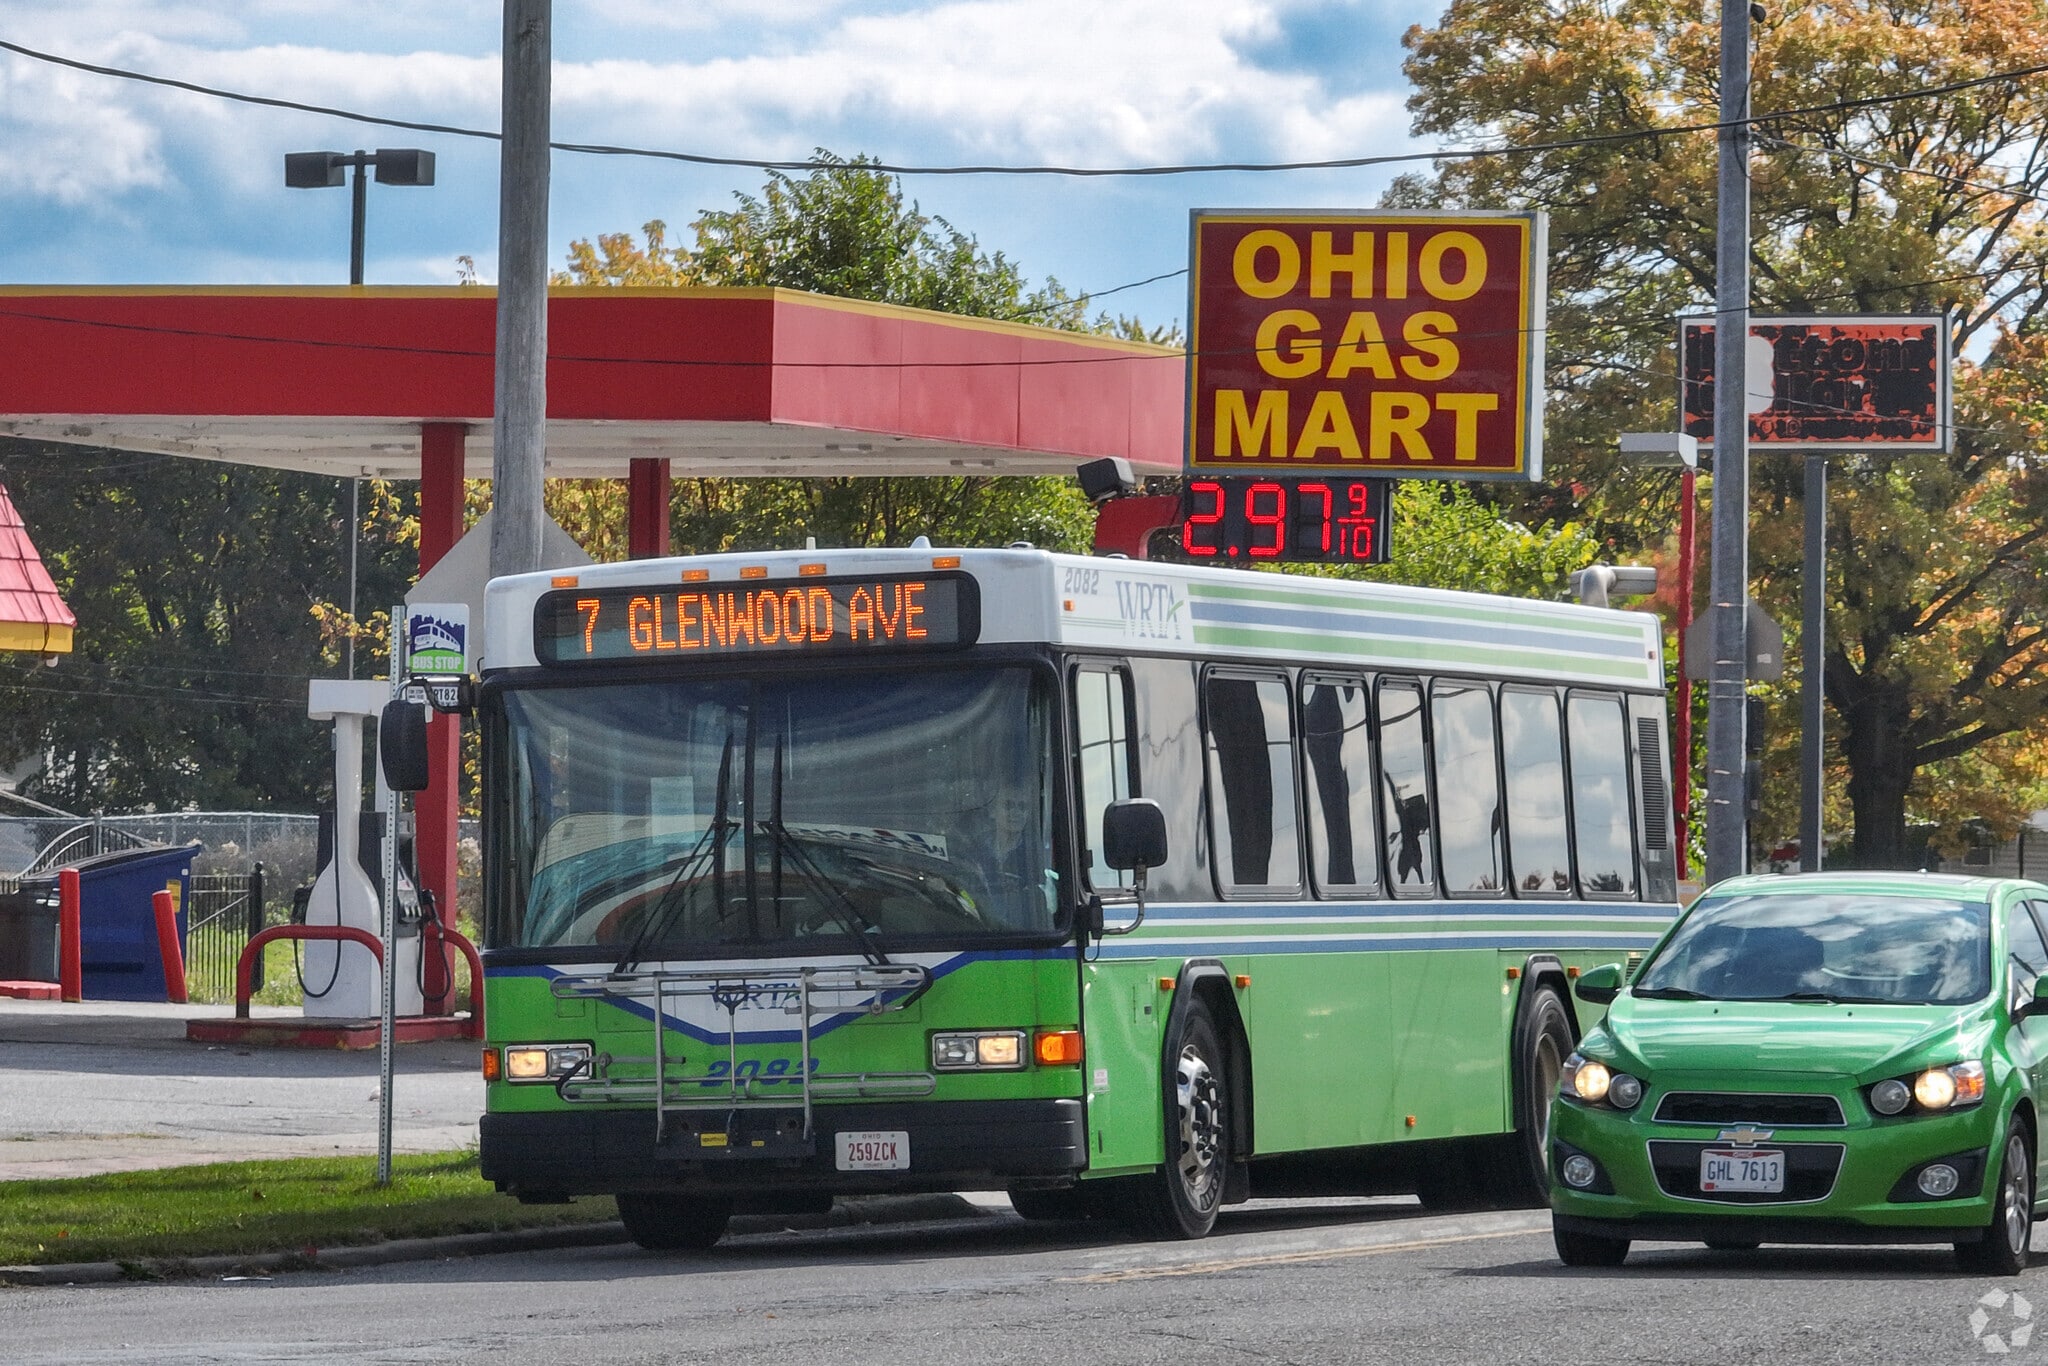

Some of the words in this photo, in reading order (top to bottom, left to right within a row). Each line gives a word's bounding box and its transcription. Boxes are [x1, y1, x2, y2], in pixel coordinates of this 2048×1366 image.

[1232, 229, 1488, 301] OHIO
[1255, 309, 1460, 381] GAS
[1213, 389, 1498, 461] MART
[1182, 482, 1332, 557] 2.97
[1064, 567, 1100, 595] 2082
[1115, 580, 1184, 640] WRTA
[576, 599, 600, 653] 7
[627, 587, 834, 652] GLENWOOD
[849, 583, 929, 641] AVE
[413, 655, 434, 669] BUS
[435, 656, 462, 670] STOP
[848, 1142, 897, 1161] 259ZCK
[1707, 1160, 1734, 1181] GHL
[1741, 1160, 1778, 1182] 7613
